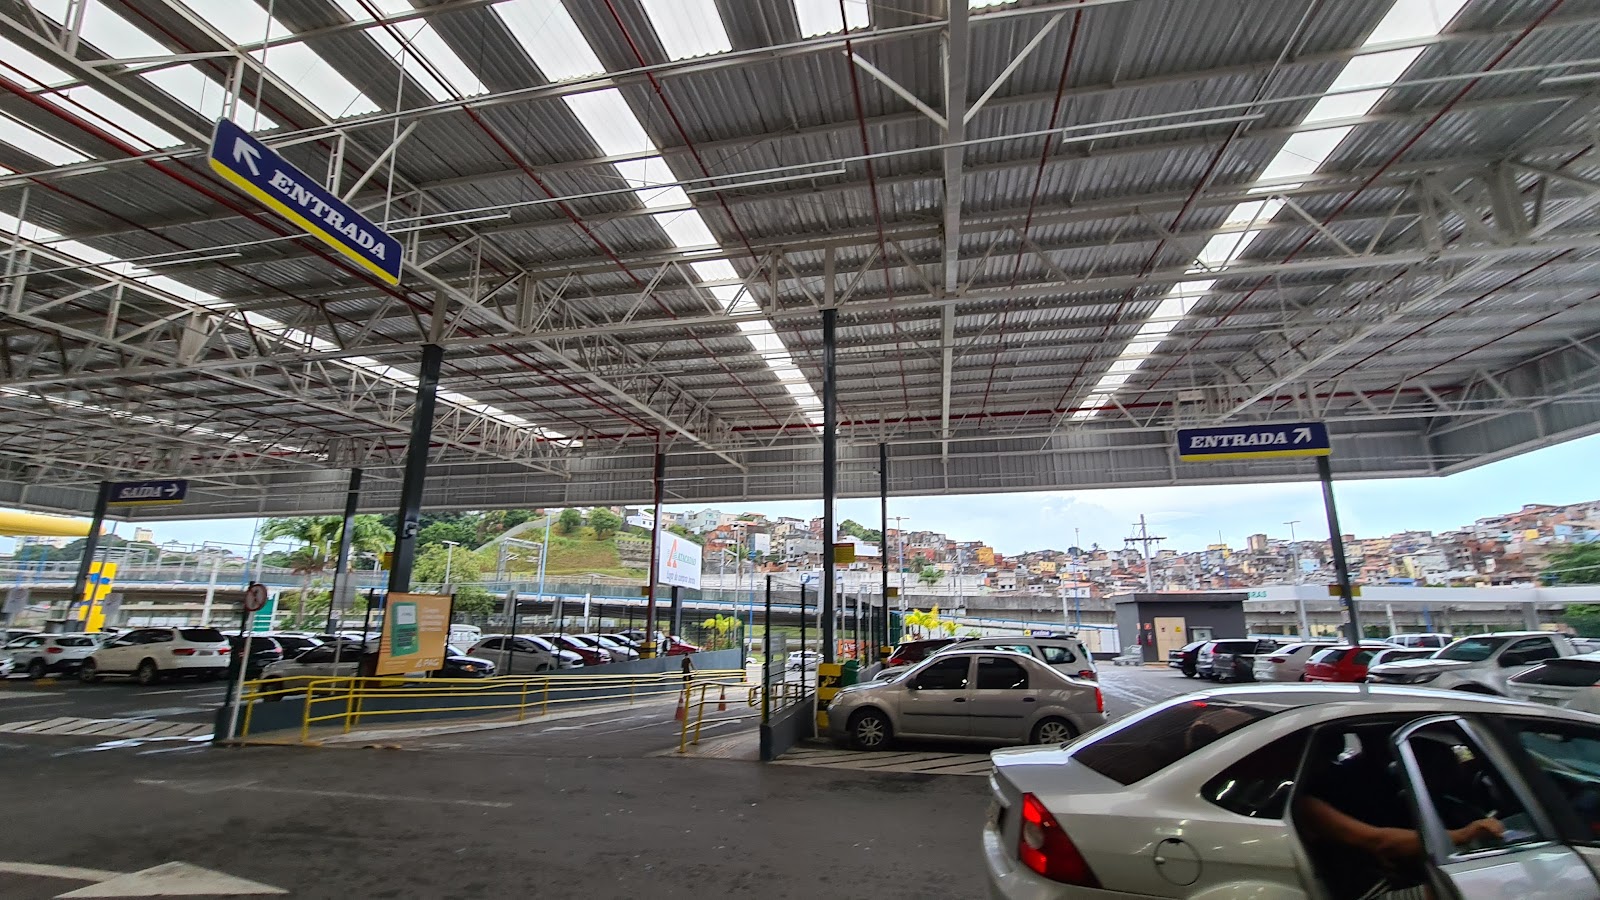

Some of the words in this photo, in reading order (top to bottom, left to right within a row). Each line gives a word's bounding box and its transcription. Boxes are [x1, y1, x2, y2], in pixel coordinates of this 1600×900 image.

[268, 169, 386, 261] ENTRADA
[1189, 432, 1288, 449] ENTRADA
[119, 483, 163, 498] SAÍDA
